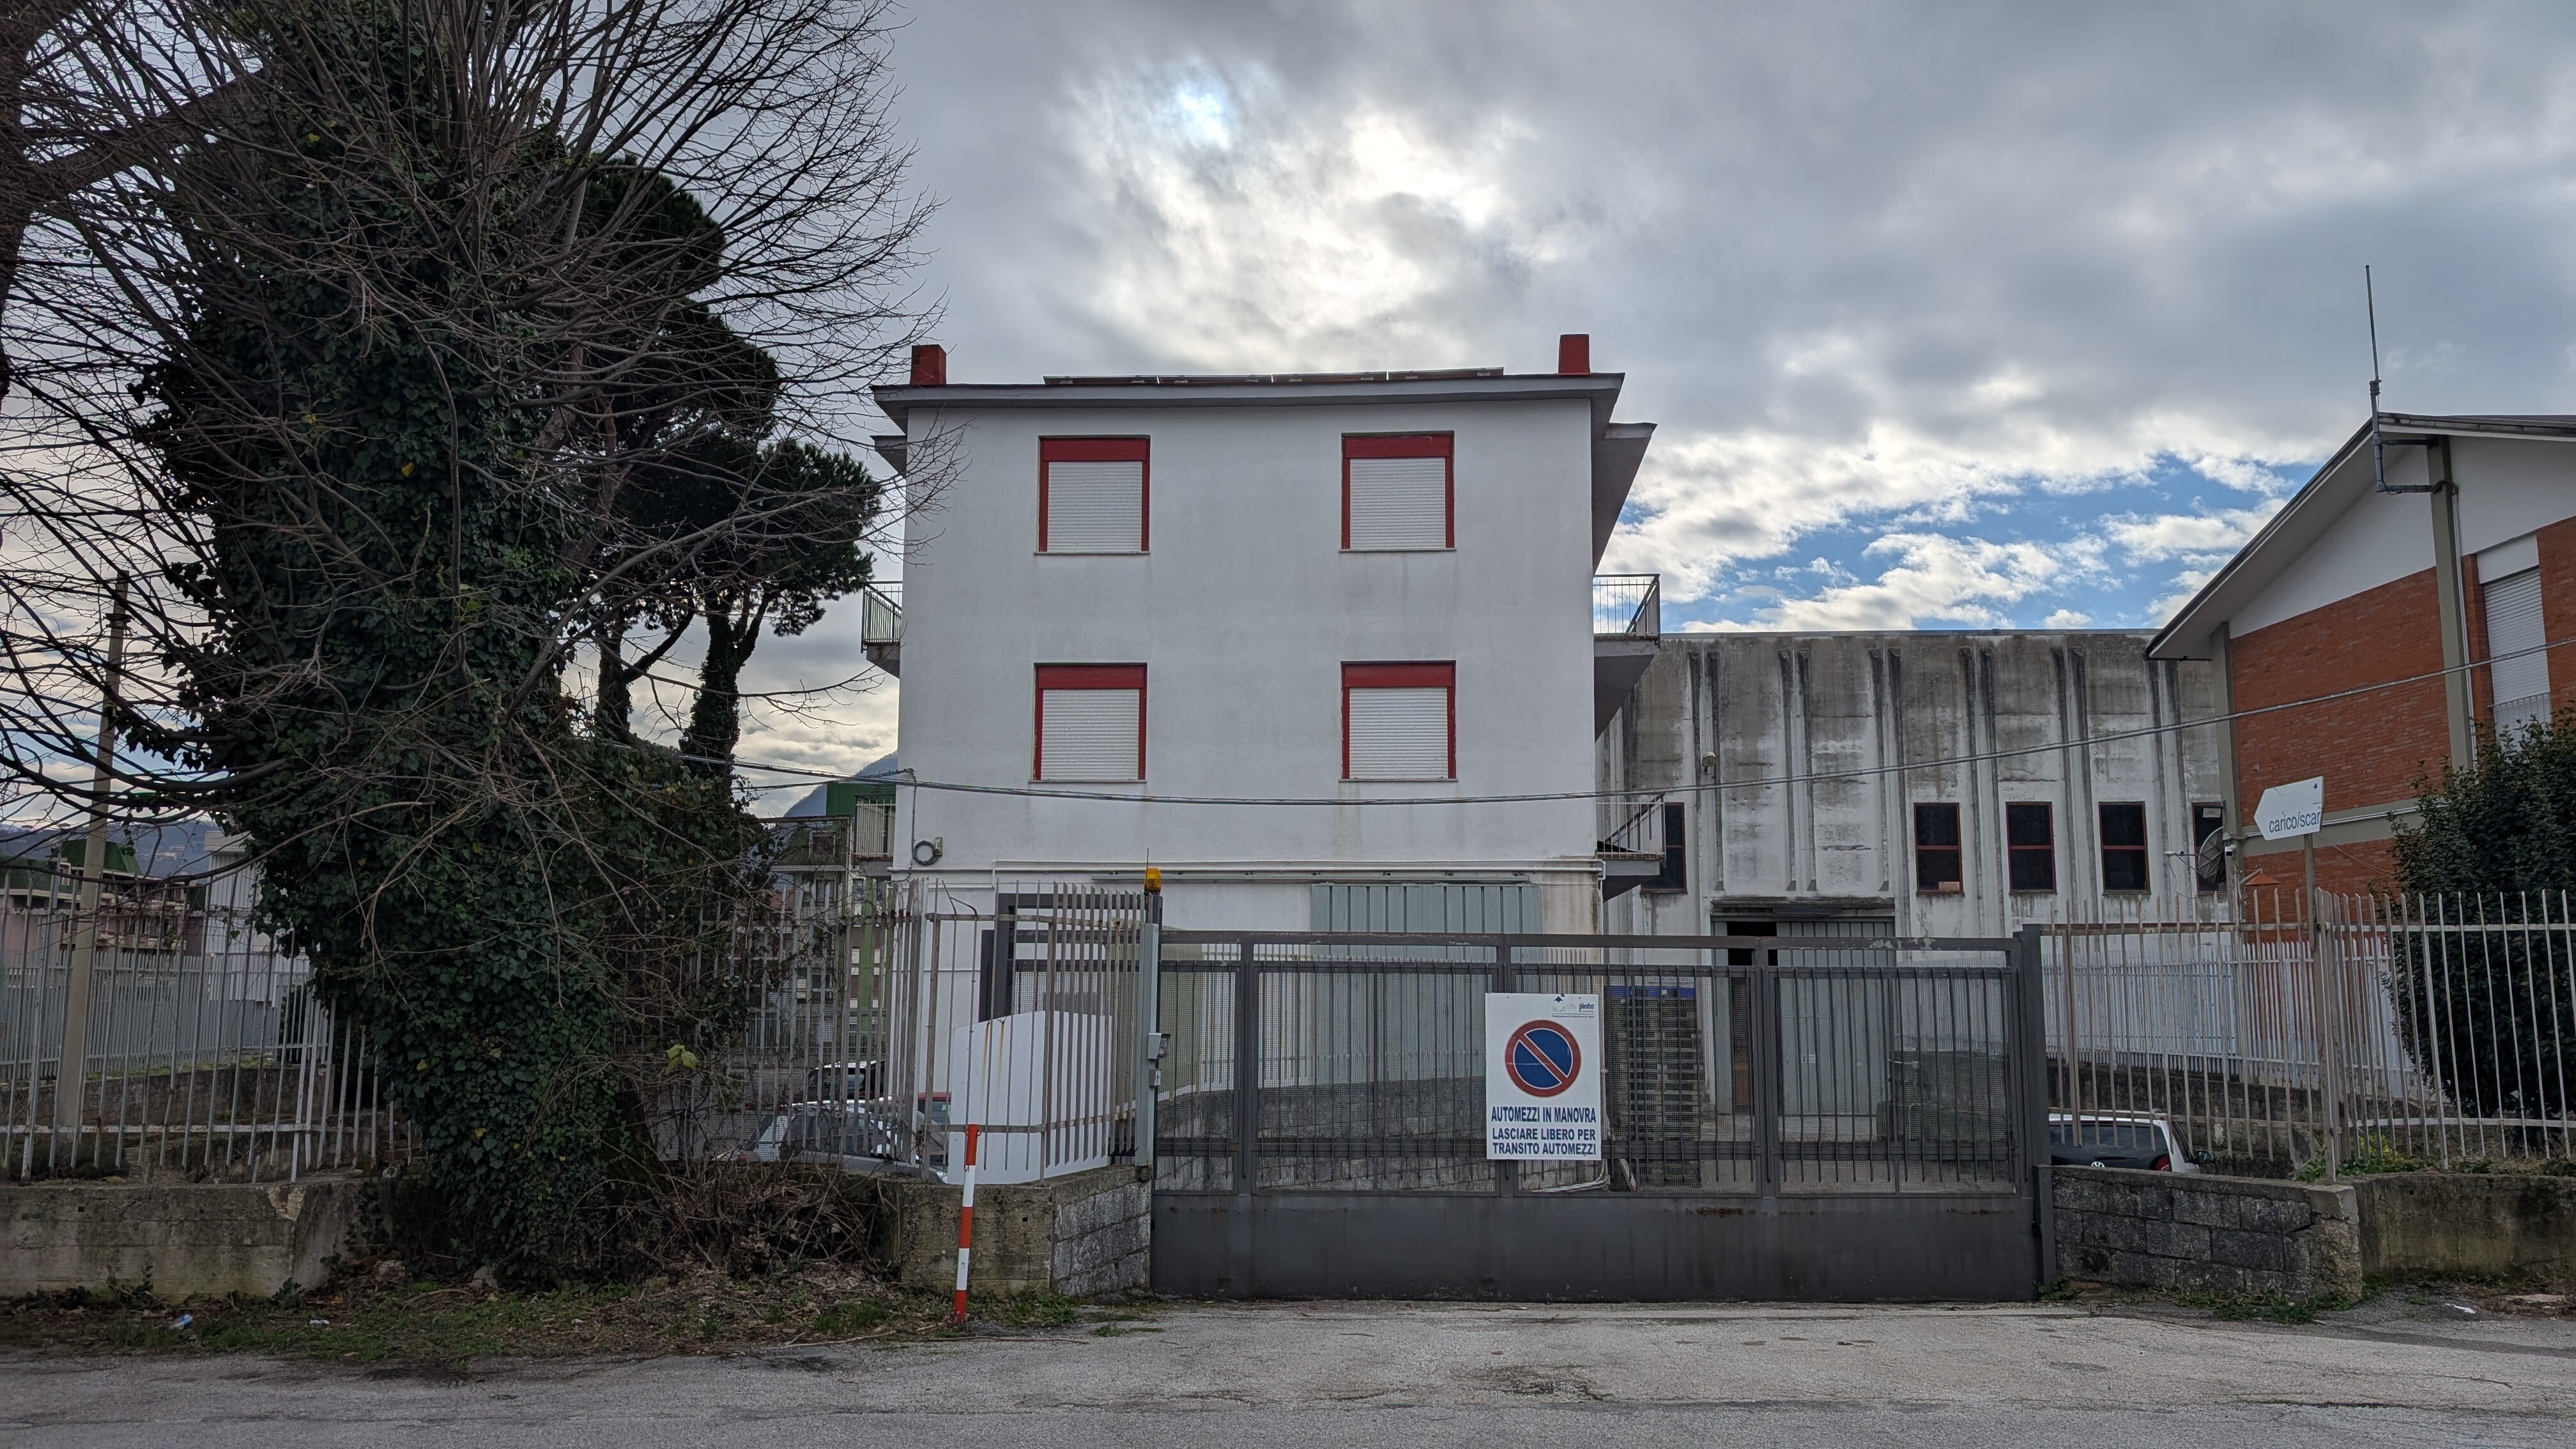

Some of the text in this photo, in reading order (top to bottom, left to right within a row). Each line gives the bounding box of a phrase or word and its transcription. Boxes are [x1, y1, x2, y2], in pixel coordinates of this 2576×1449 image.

[1579, 1003, 1594, 1013] pinto
[1491, 1106, 1597, 1123] AUTOMEZZI IN MANOVRA
[1492, 1128, 1596, 1141] LASCIARE LIBERO PER
[1492, 1142, 1597, 1155] TRANSITO AUTOMEZZI
